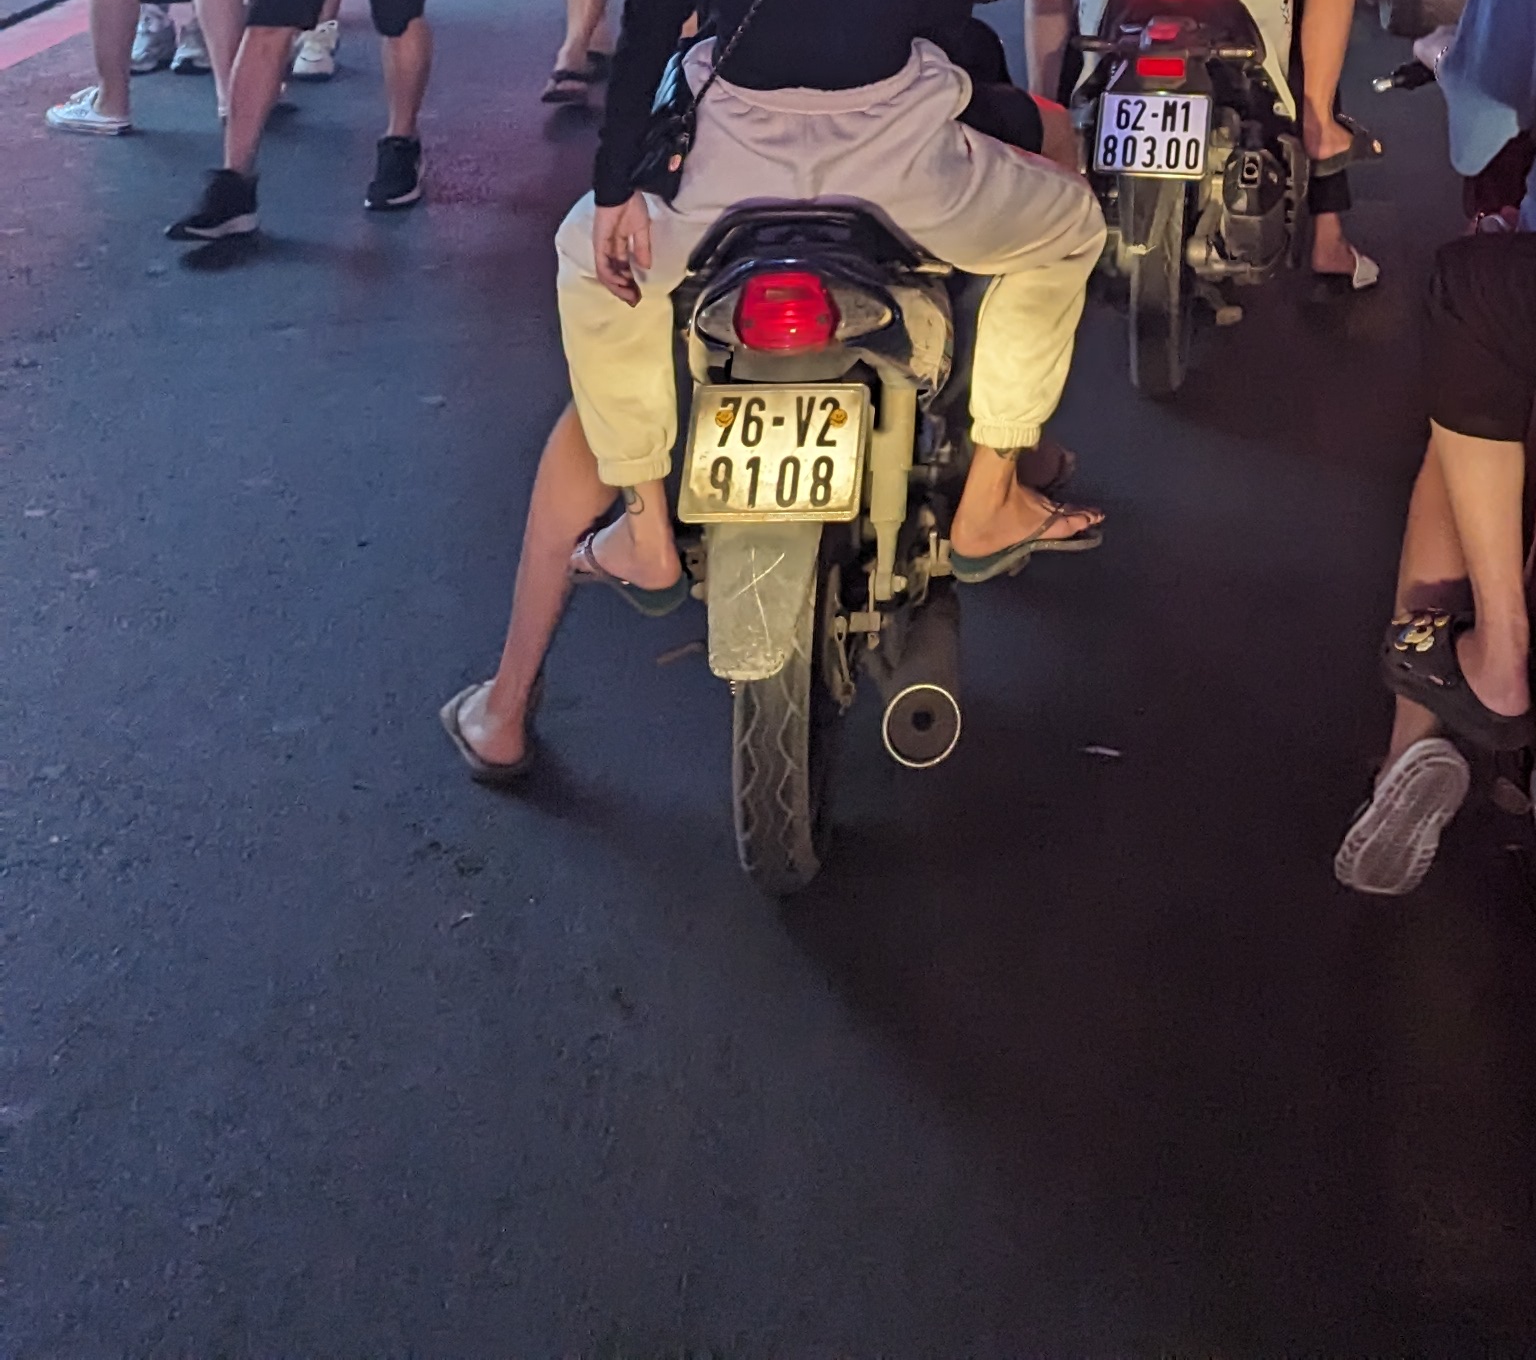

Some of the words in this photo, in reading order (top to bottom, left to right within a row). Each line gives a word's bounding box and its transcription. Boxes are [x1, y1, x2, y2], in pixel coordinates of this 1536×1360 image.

[1103, 134, 1201, 170] 803.00
[717, 396, 841, 448] 76-V2
[711, 455, 834, 509] 9108
